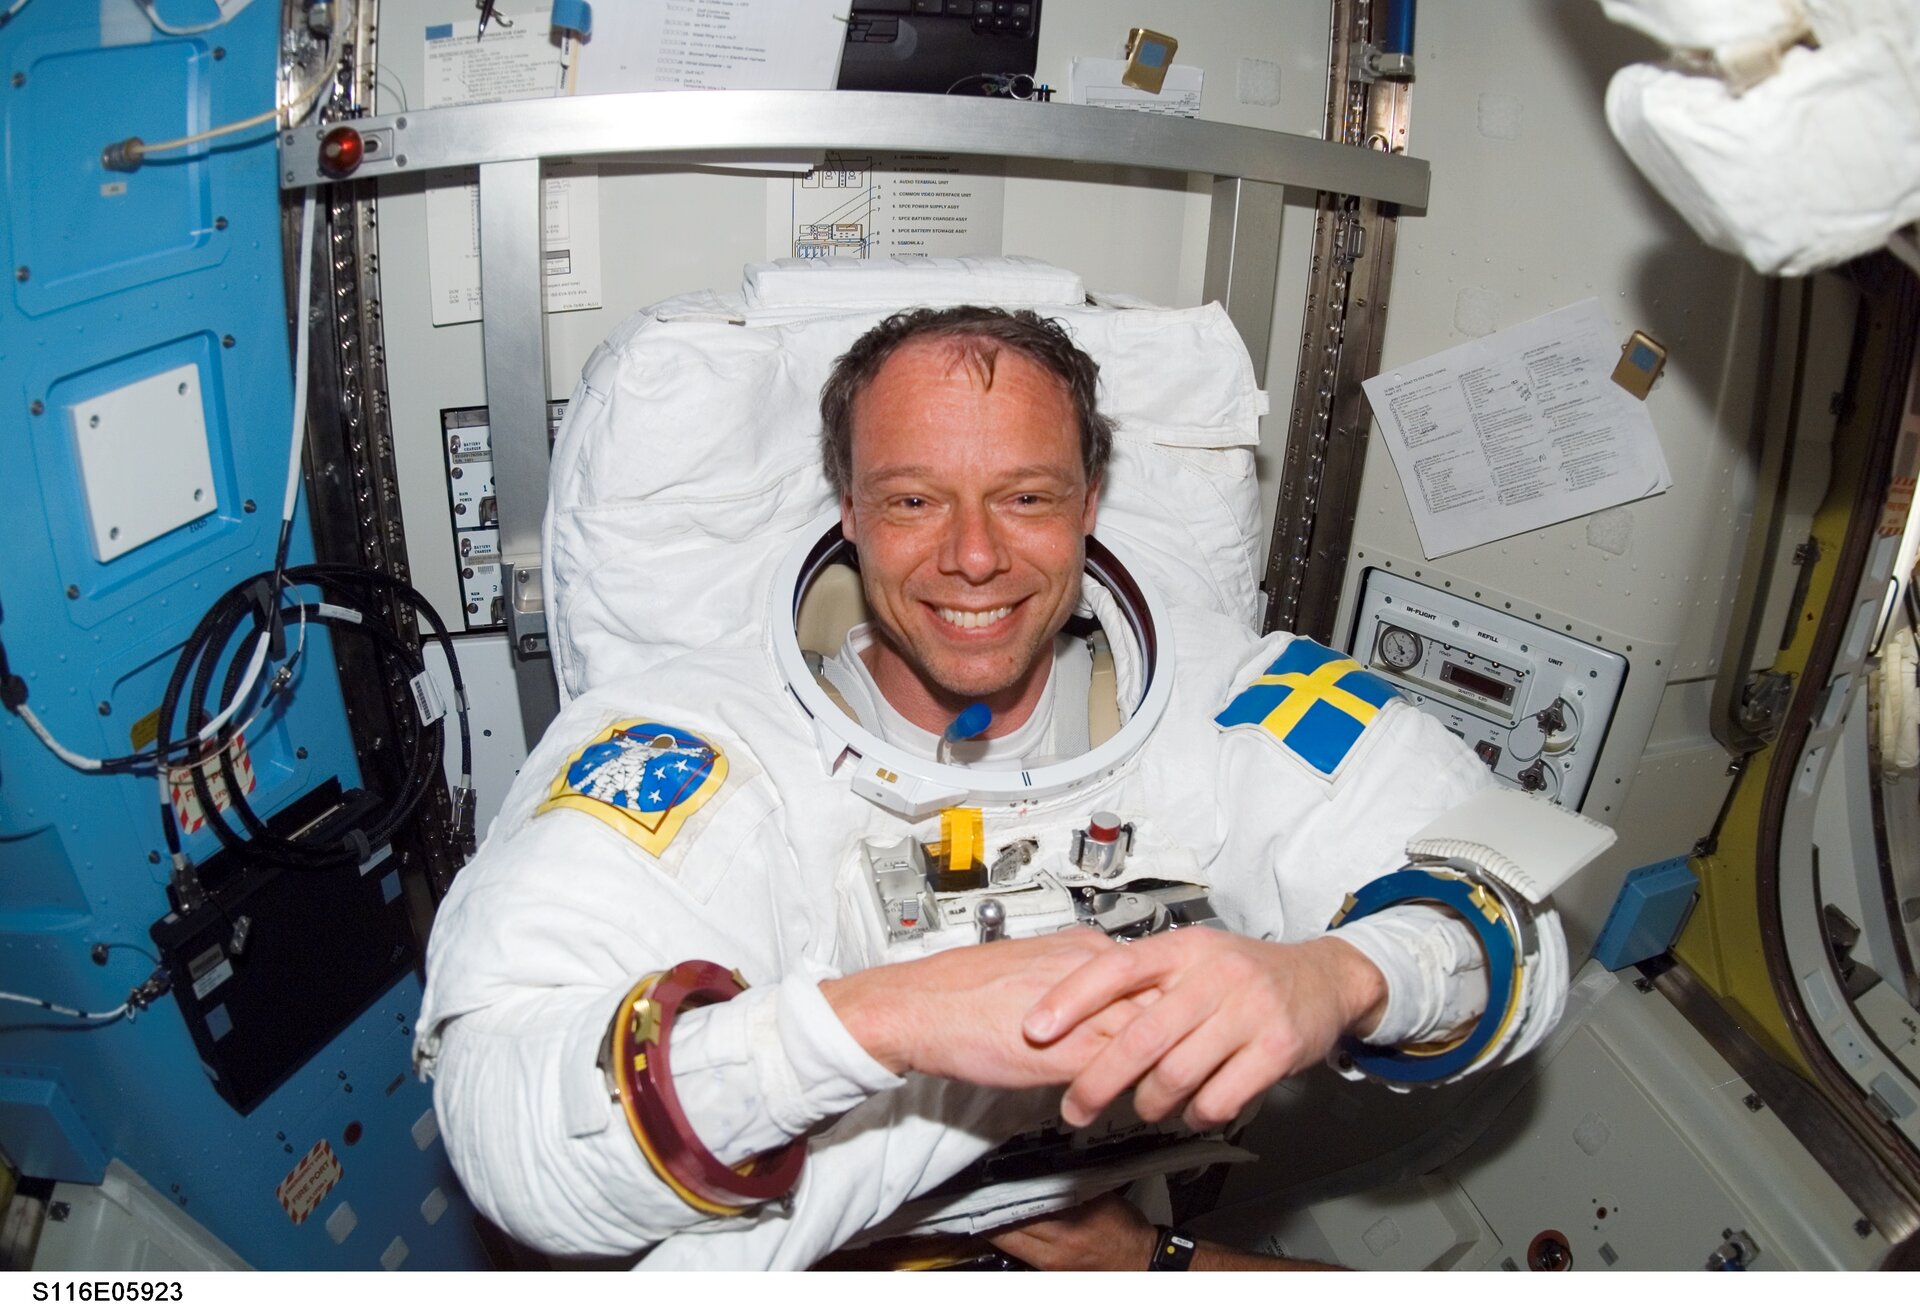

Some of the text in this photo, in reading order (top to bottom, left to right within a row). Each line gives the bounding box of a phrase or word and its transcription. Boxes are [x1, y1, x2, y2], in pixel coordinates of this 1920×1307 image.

[1406, 606, 1437, 621] IN-FLIGHT
[1477, 631, 1499, 644] REFILL
[1548, 657, 1563, 667] UNIT
[292, 1183, 310, 1204] FIRE
[309, 1160, 329, 1185] PORT
